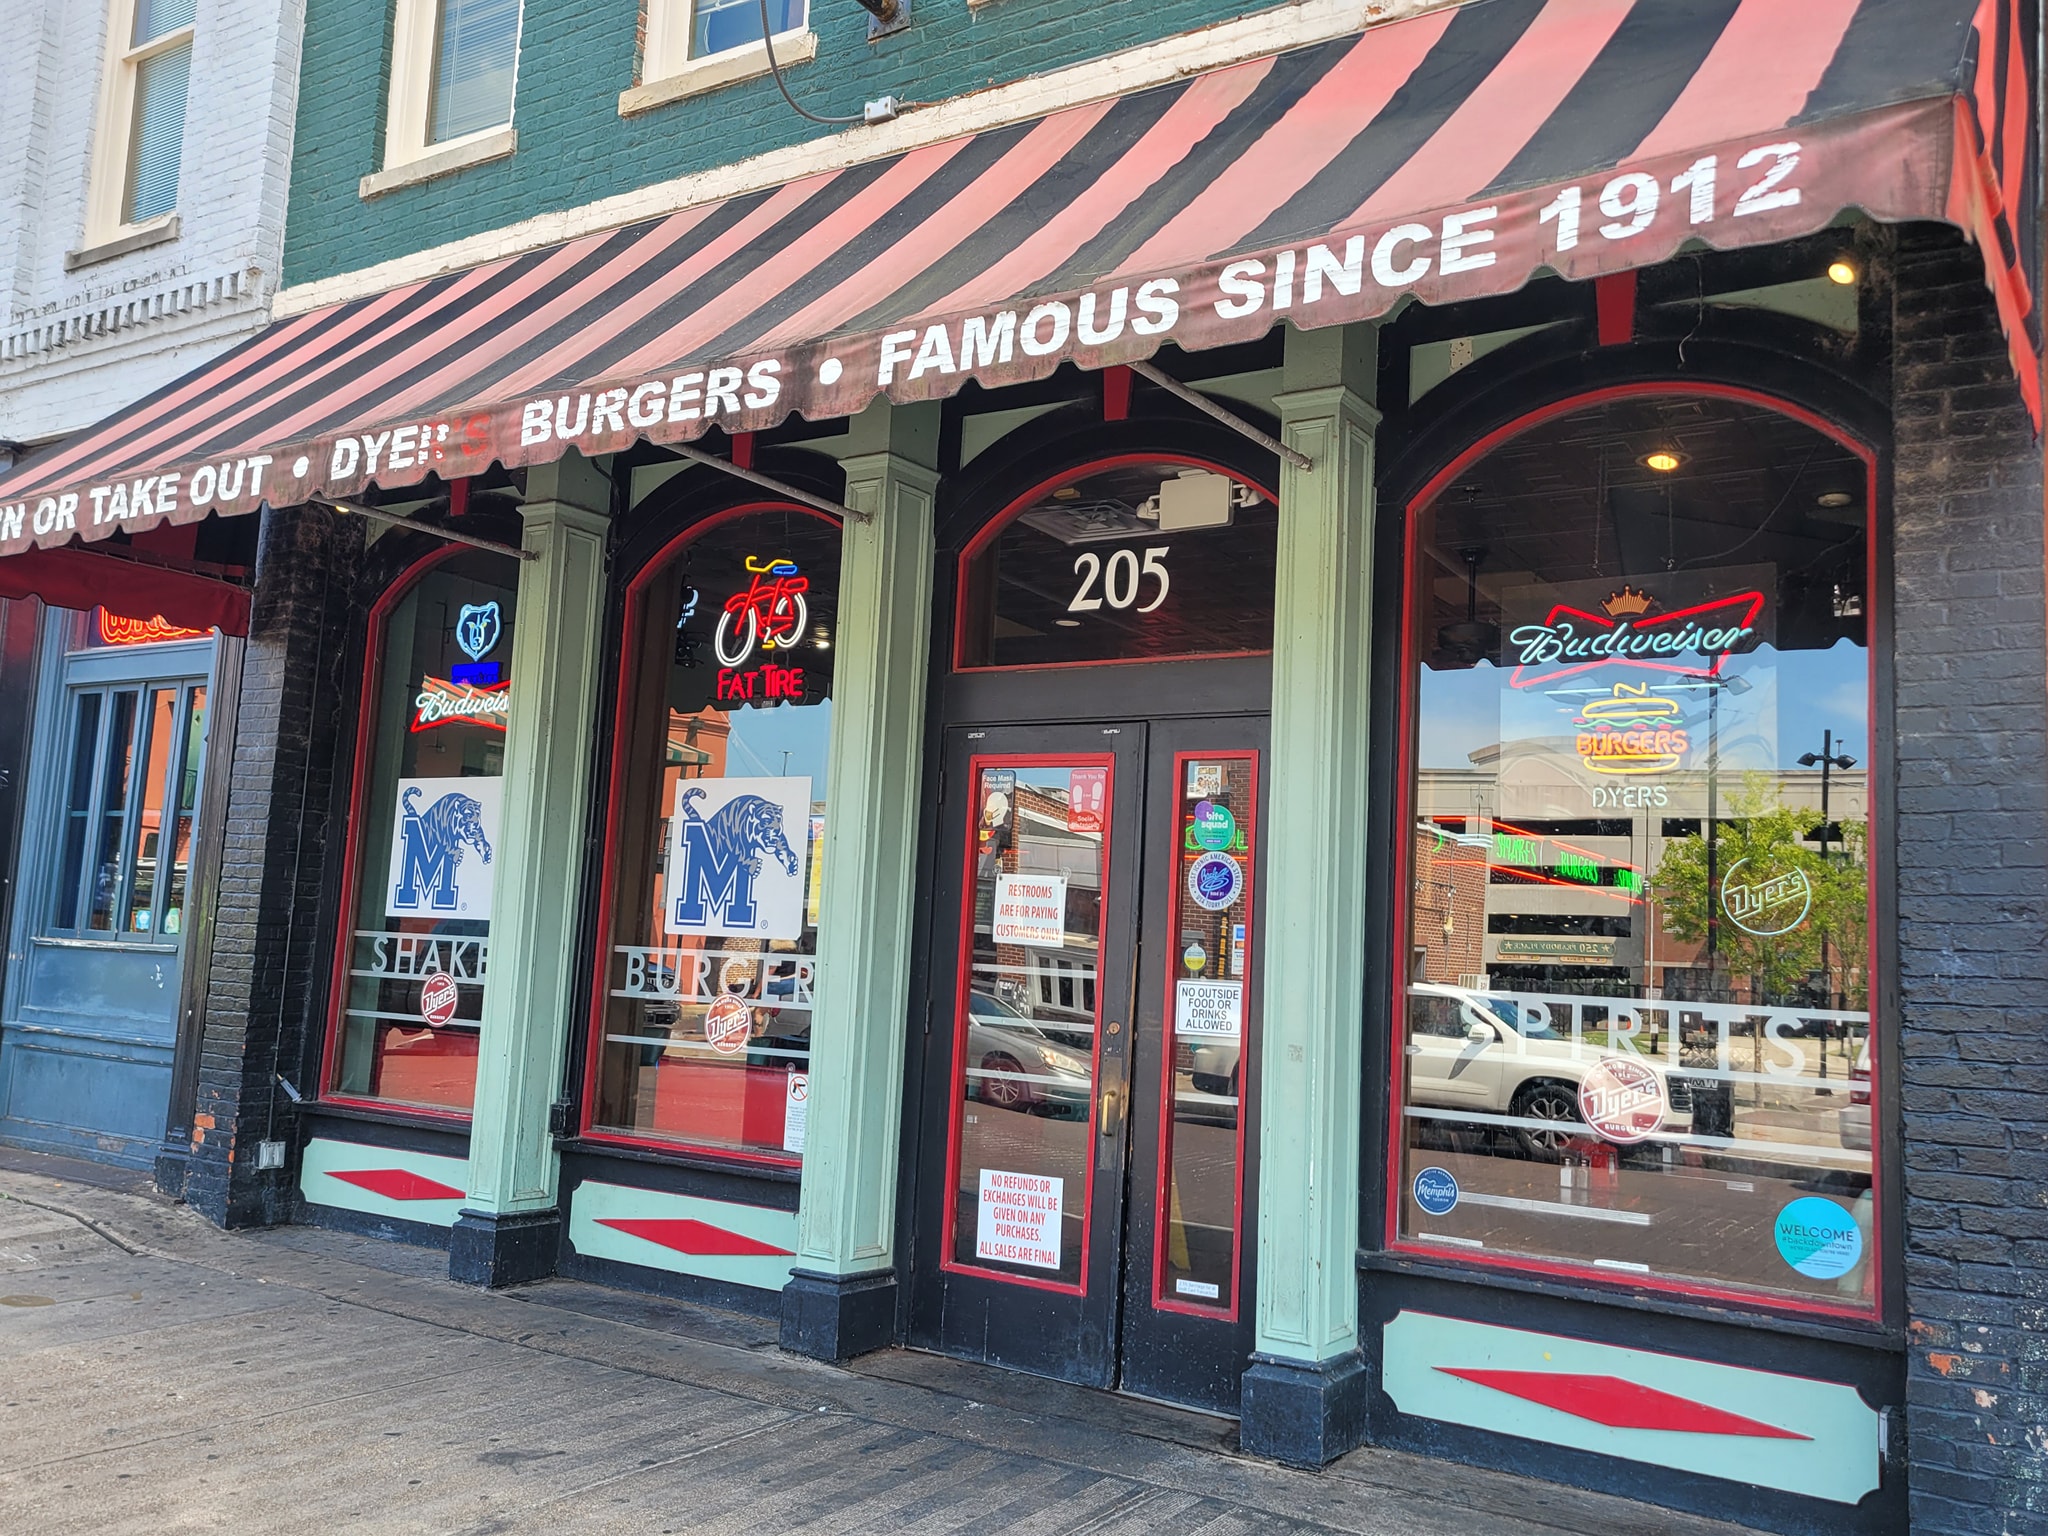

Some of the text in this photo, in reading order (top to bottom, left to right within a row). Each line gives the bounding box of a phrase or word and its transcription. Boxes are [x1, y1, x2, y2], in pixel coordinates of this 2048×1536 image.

[0, 503, 25, 541] N
[33, 492, 79, 535] OR
[89, 472, 180, 523] TAKE
[190, 455, 273, 502] OUT
[521, 358, 782, 447] BURGERS
[877, 277, 1180, 386] FAMOUS
[1213, 206, 1497, 320] SINCE
[1538, 140, 1802, 253] 1912
[1067, 546, 1170, 613] 205
[1511, 622, 1753, 664] Budweiser
[717, 664, 803, 701] FAT TIRE
[416, 688, 511, 723] Budweis
[1576, 730, 1689, 755] BURGERS
[998, 774, 1013, 782] Mask
[1592, 786, 1669, 808] DYERS
[1201, 820, 1229, 830] squad
[1206, 811, 1224, 820] bite
[1210, 853, 1234, 868] AMERICAN
[1560, 850, 1598, 884] BURGERS
[1008, 884, 1053, 899] RESTROOMS
[1733, 874, 1801, 916] Dyer's
[1000, 904, 1014, 917] ARE
[1015, 905, 1030, 918] FOR
[1031, 906, 1058, 920] PAYING
[996, 923, 1060, 941] CUSTOMERS ONLY
[625, 950, 816, 1005] BURGER
[1182, 987, 1239, 999] NO OUTSIDE
[1189, 998, 1231, 1010] FOOD OR
[1192, 1008, 1227, 1020] DRINKS
[1186, 1018, 1232, 1031] ALLOWED
[1460, 993, 1806, 1077] SPIRITS
[1590, 1081, 1657, 1119] Dyer's
[992, 1173, 1050, 1193] NO REFUNDS OR
[1417, 1184, 1455, 1200] Memphis
[983, 1189, 1058, 1211] EXCHANGES WILL BE
[993, 1206, 1046, 1226] GIVEN ON ANY
[995, 1223, 1042, 1242] PURCHASES.
[1779, 1223, 1854, 1242] WELCOME
[979, 1241, 1057, 1265] ALL SALES ARE FINAL
